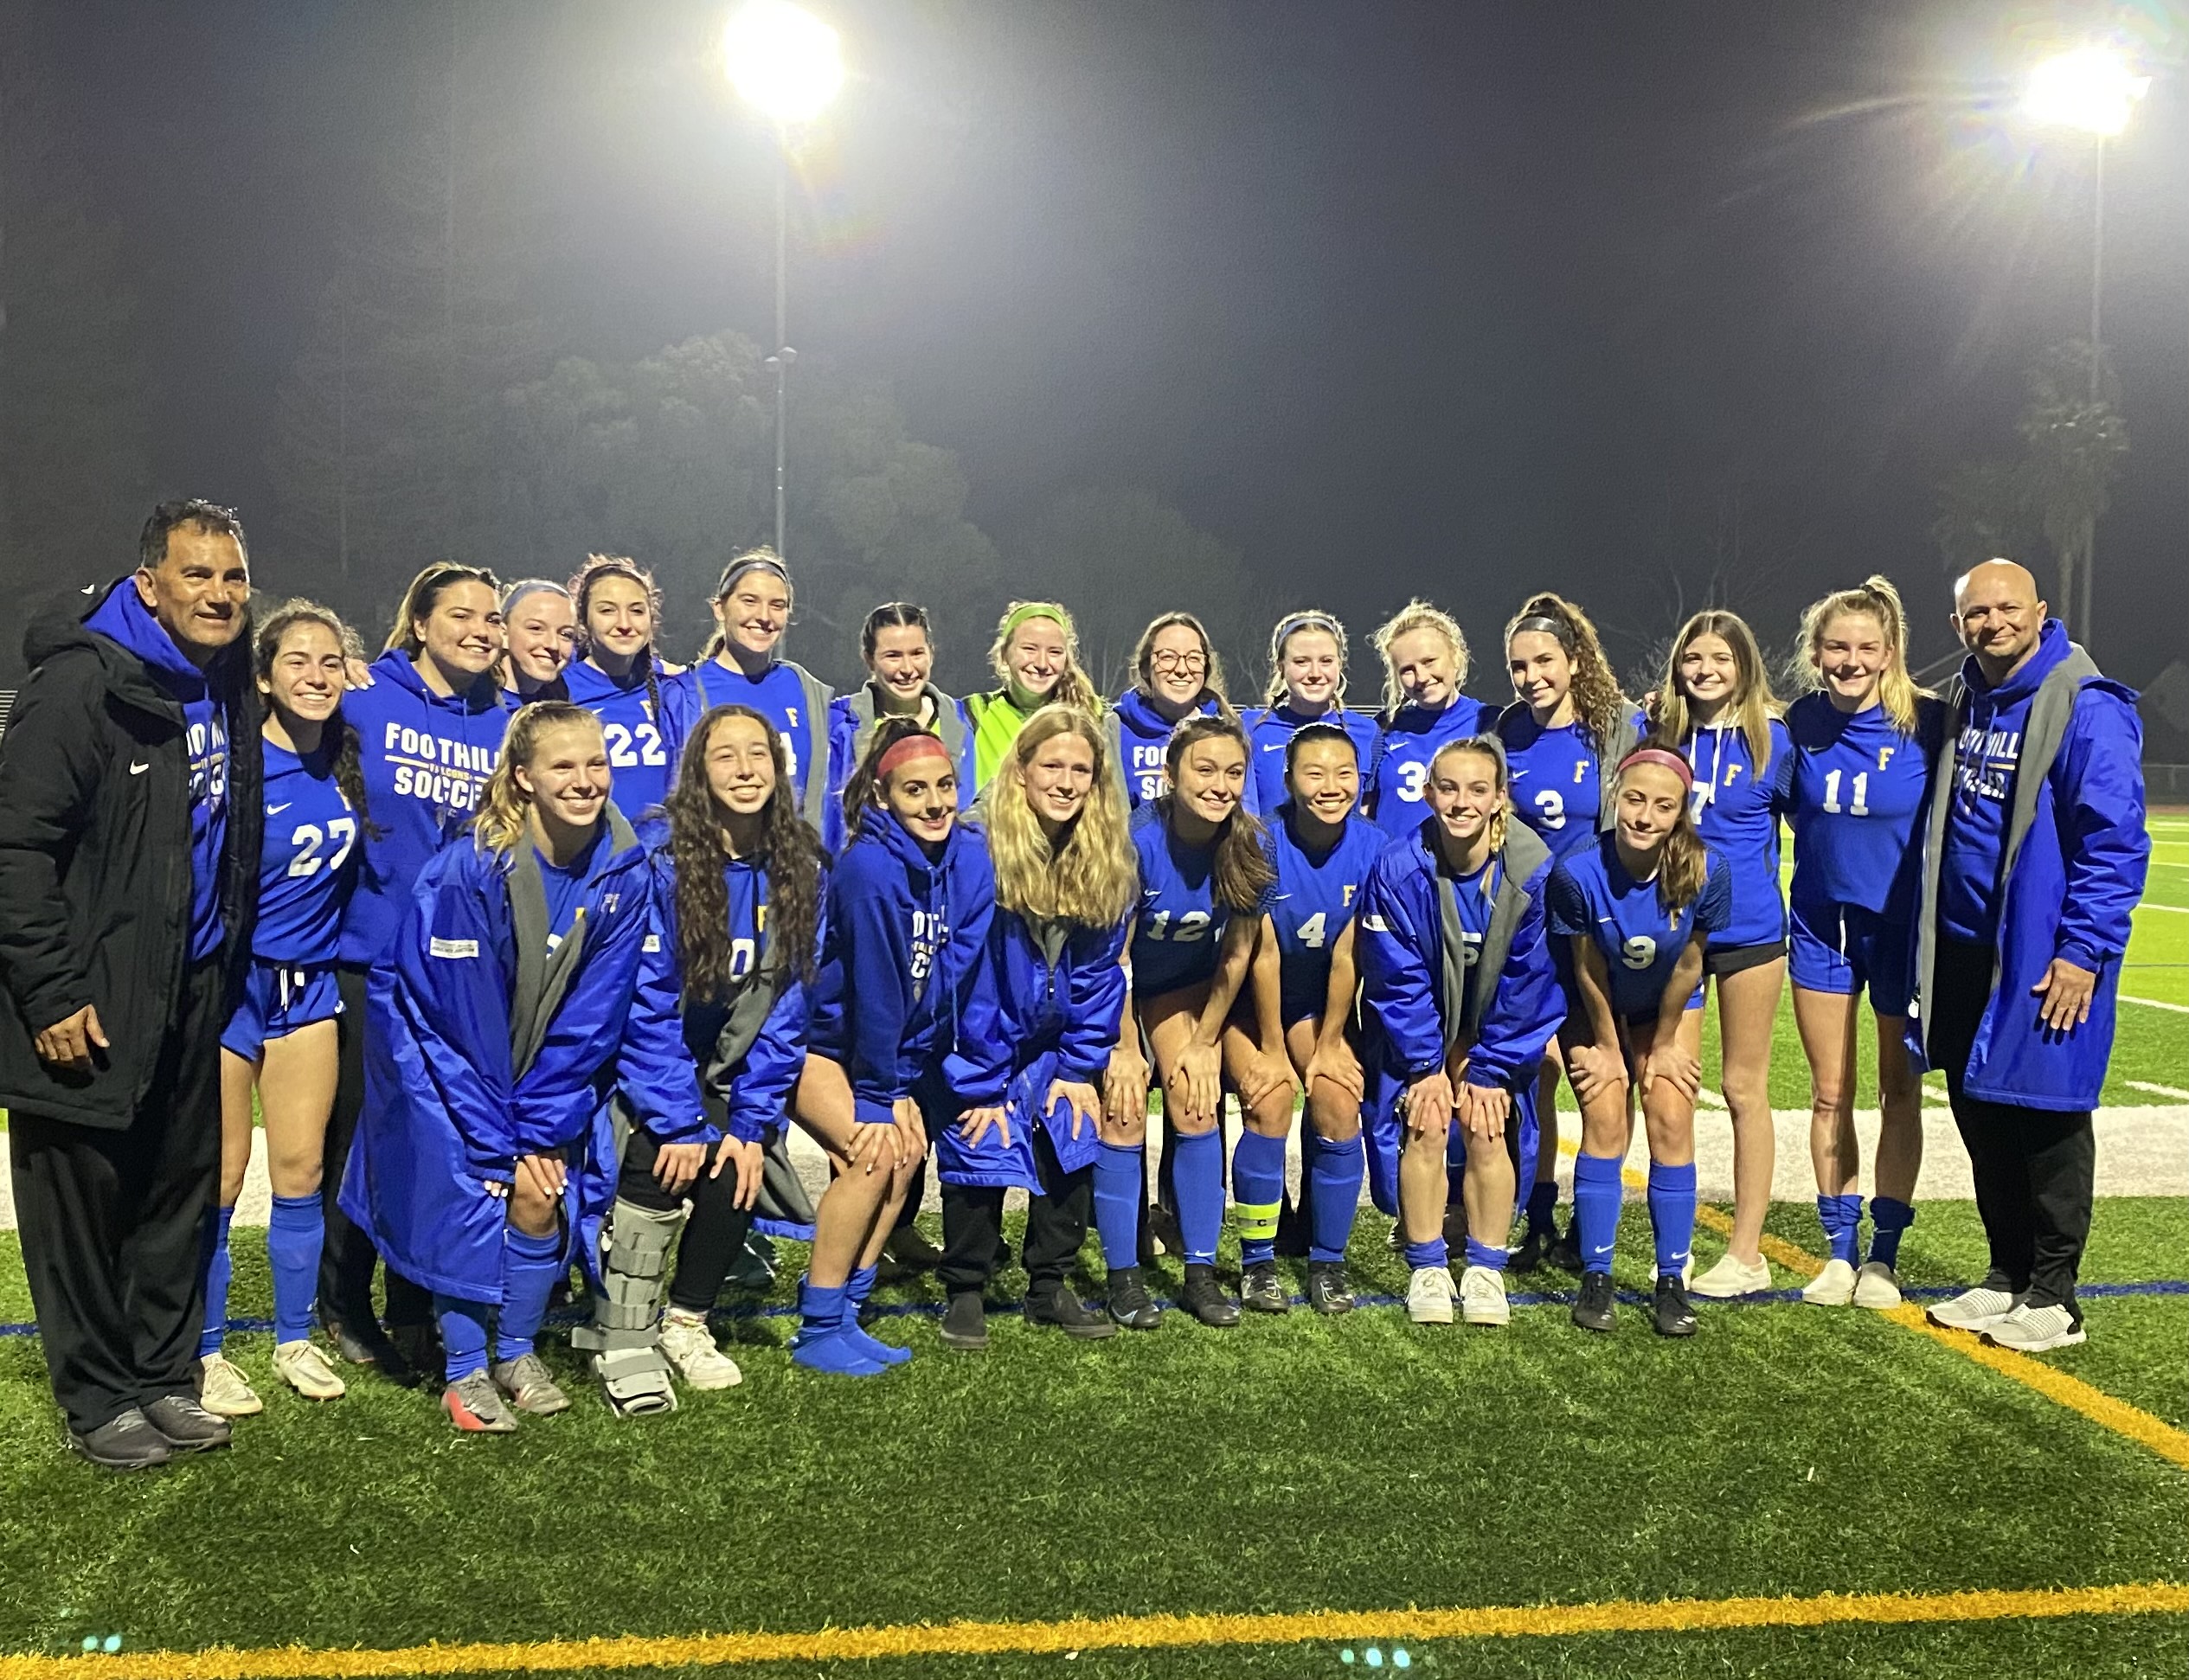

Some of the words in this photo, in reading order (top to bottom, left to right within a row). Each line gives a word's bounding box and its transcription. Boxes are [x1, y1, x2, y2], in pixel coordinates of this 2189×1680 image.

[603, 723, 666, 767] 22
[1878, 747, 1895, 771] F
[1396, 761, 1427, 803] 3
[1574, 760, 1589, 783] F
[1724, 764, 1743, 786] F
[1822, 768, 1869, 816] 11
[1534, 790, 1566, 830] 3
[287, 817, 356, 877] 27
[1342, 884, 1358, 907] F
[1146, 909, 1211, 942] 12
[1296, 912, 1326, 948] 4
[1621, 935, 1657, 970] 9
